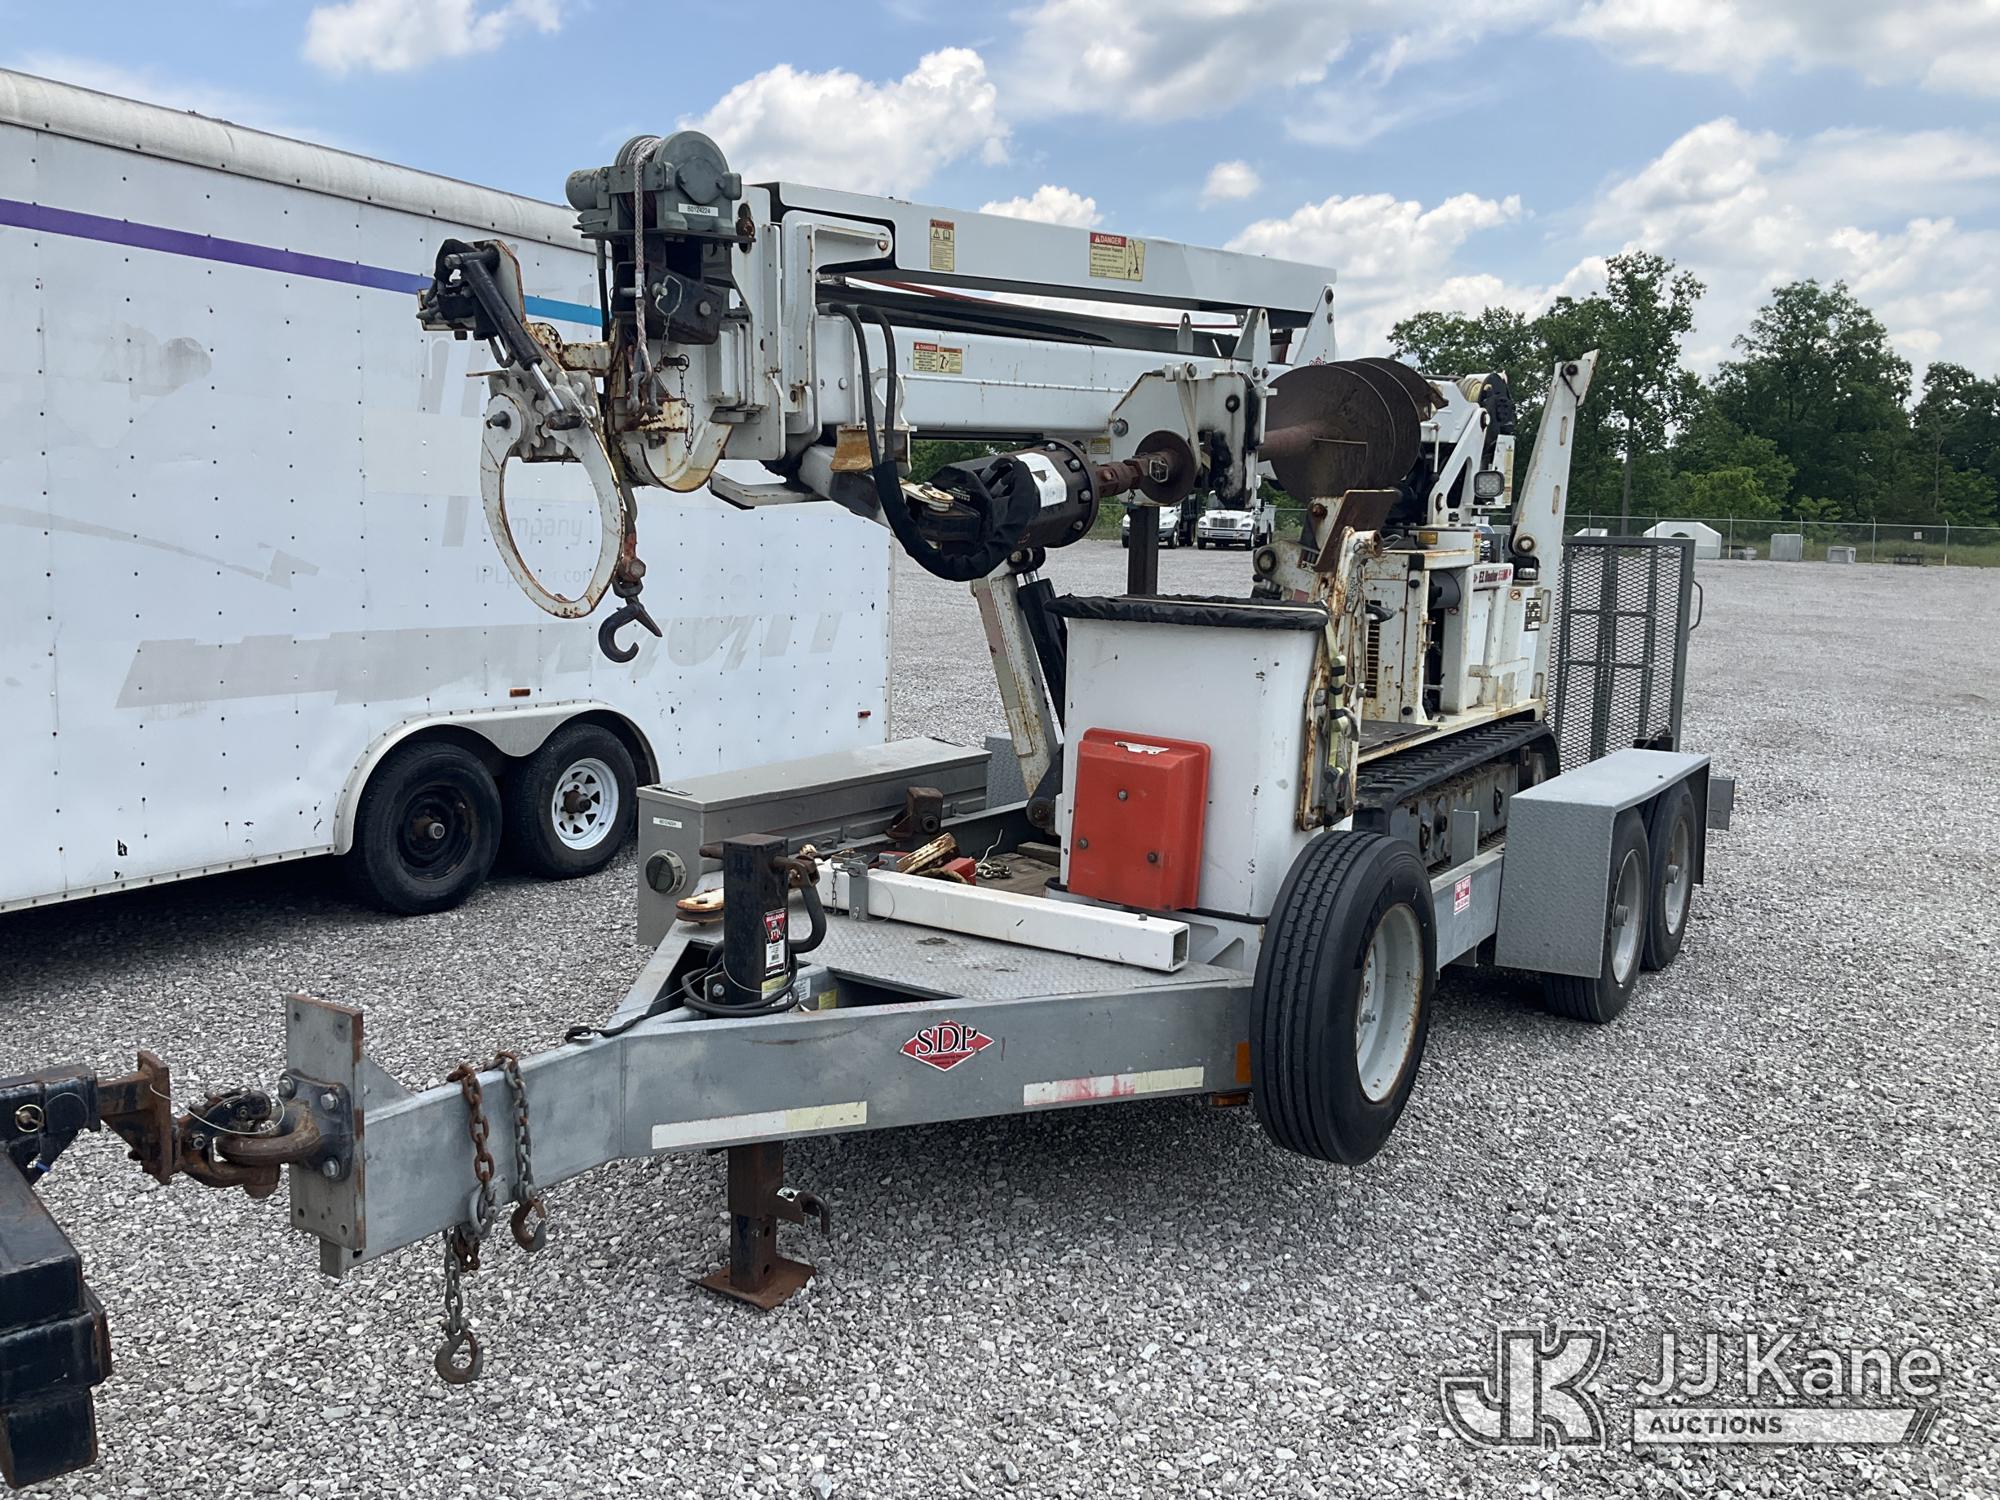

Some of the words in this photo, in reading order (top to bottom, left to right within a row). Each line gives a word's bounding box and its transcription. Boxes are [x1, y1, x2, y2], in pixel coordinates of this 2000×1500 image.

[1100, 235, 1121, 245] DANGER
[481, 517, 583, 546] cmpany
[766, 912, 785, 922] BULLDOG
